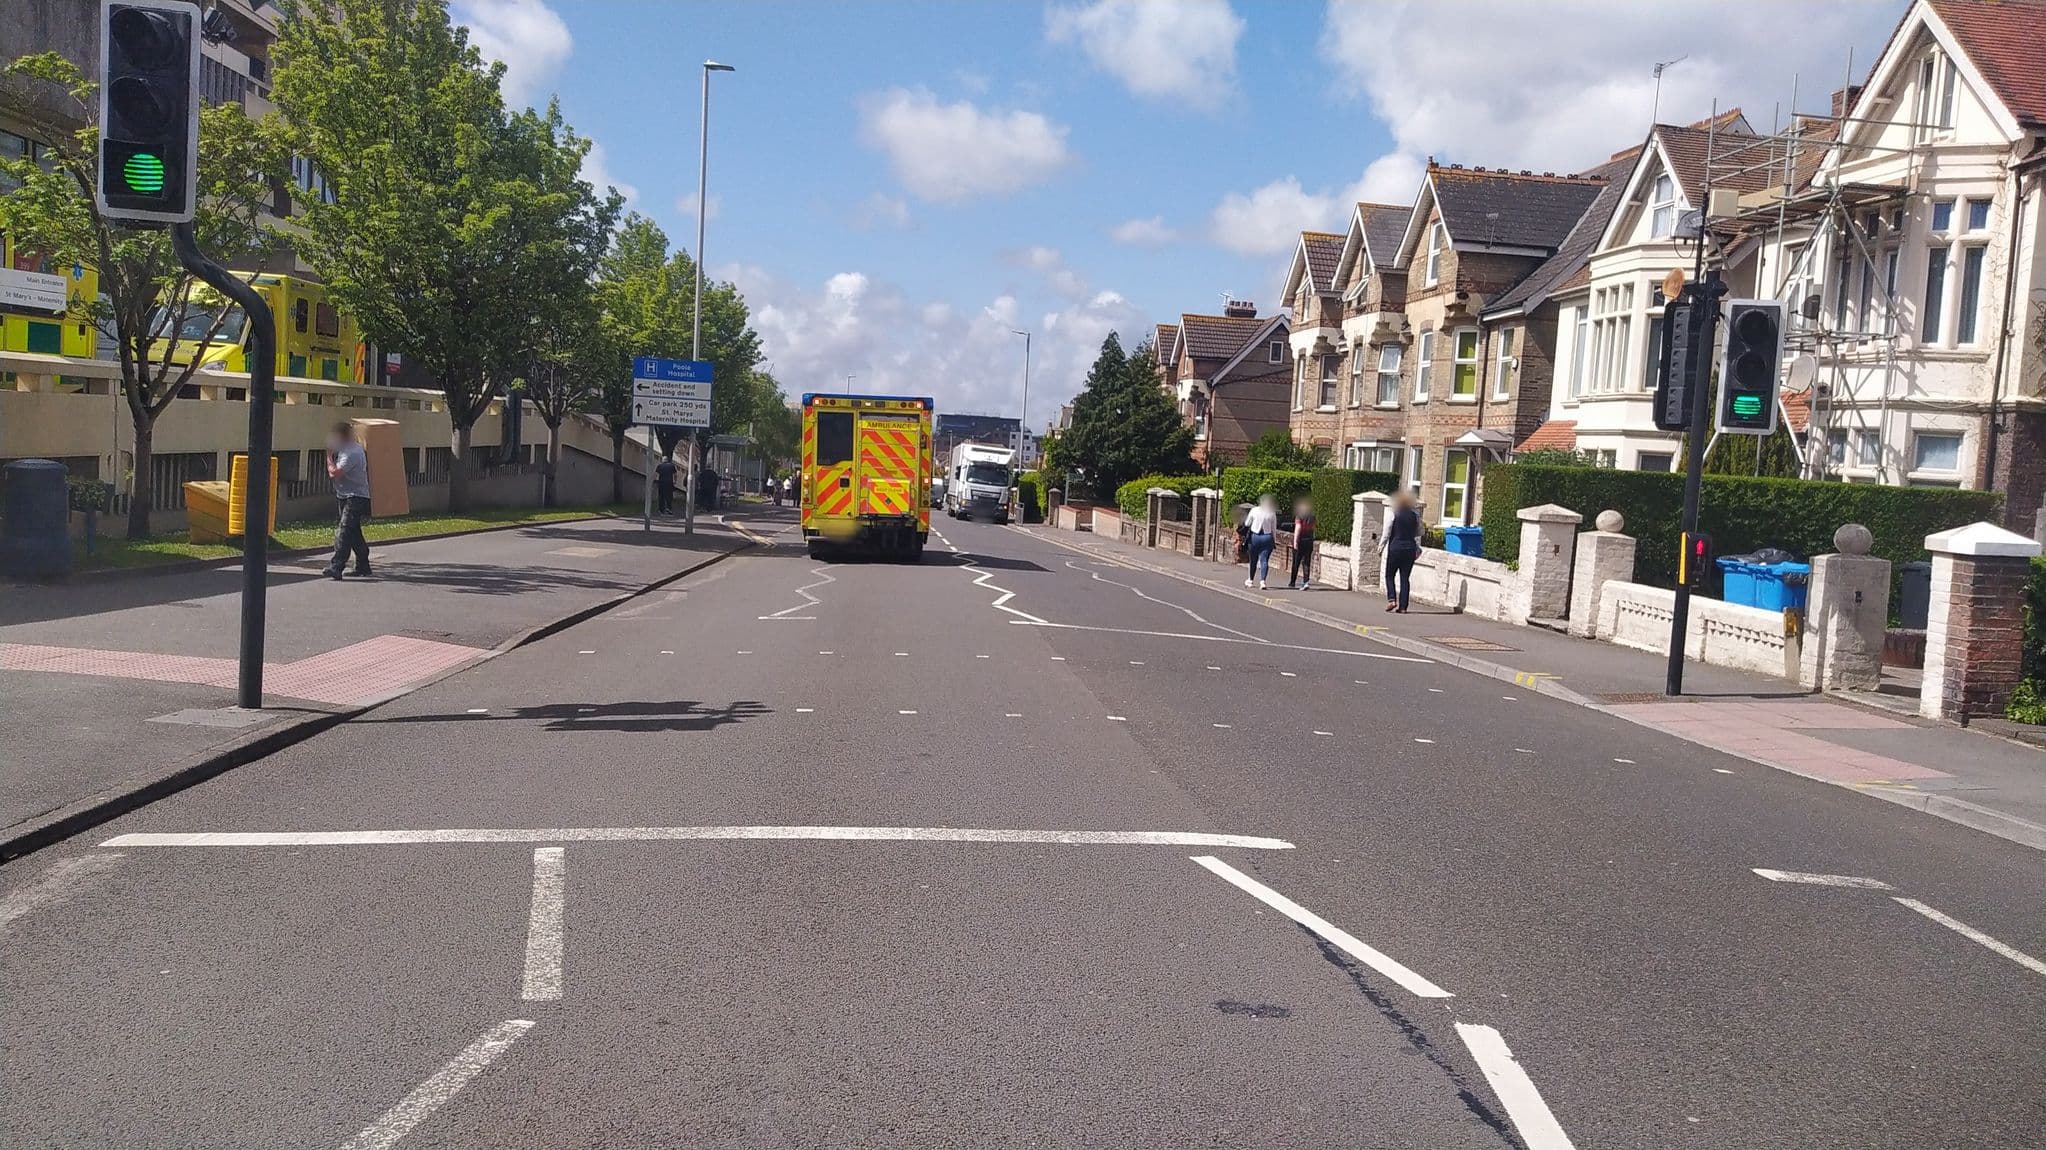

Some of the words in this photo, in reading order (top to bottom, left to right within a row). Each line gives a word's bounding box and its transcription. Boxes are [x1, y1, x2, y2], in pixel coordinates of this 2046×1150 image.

[26, 276, 40, 284] Main
[41, 278, 64, 287] Entrance
[13, 292, 31, 301] Mary's
[38, 295, 63, 305] Maternity
[646, 362, 656, 373] H
[672, 363, 691, 371] Poole
[667, 370, 696, 378] Hospital
[652, 381, 682, 389] Accident
[645, 414, 678, 424] Maternity
[679, 417, 708, 425] Hospital
[867, 421, 912, 429] AMBULANCE
